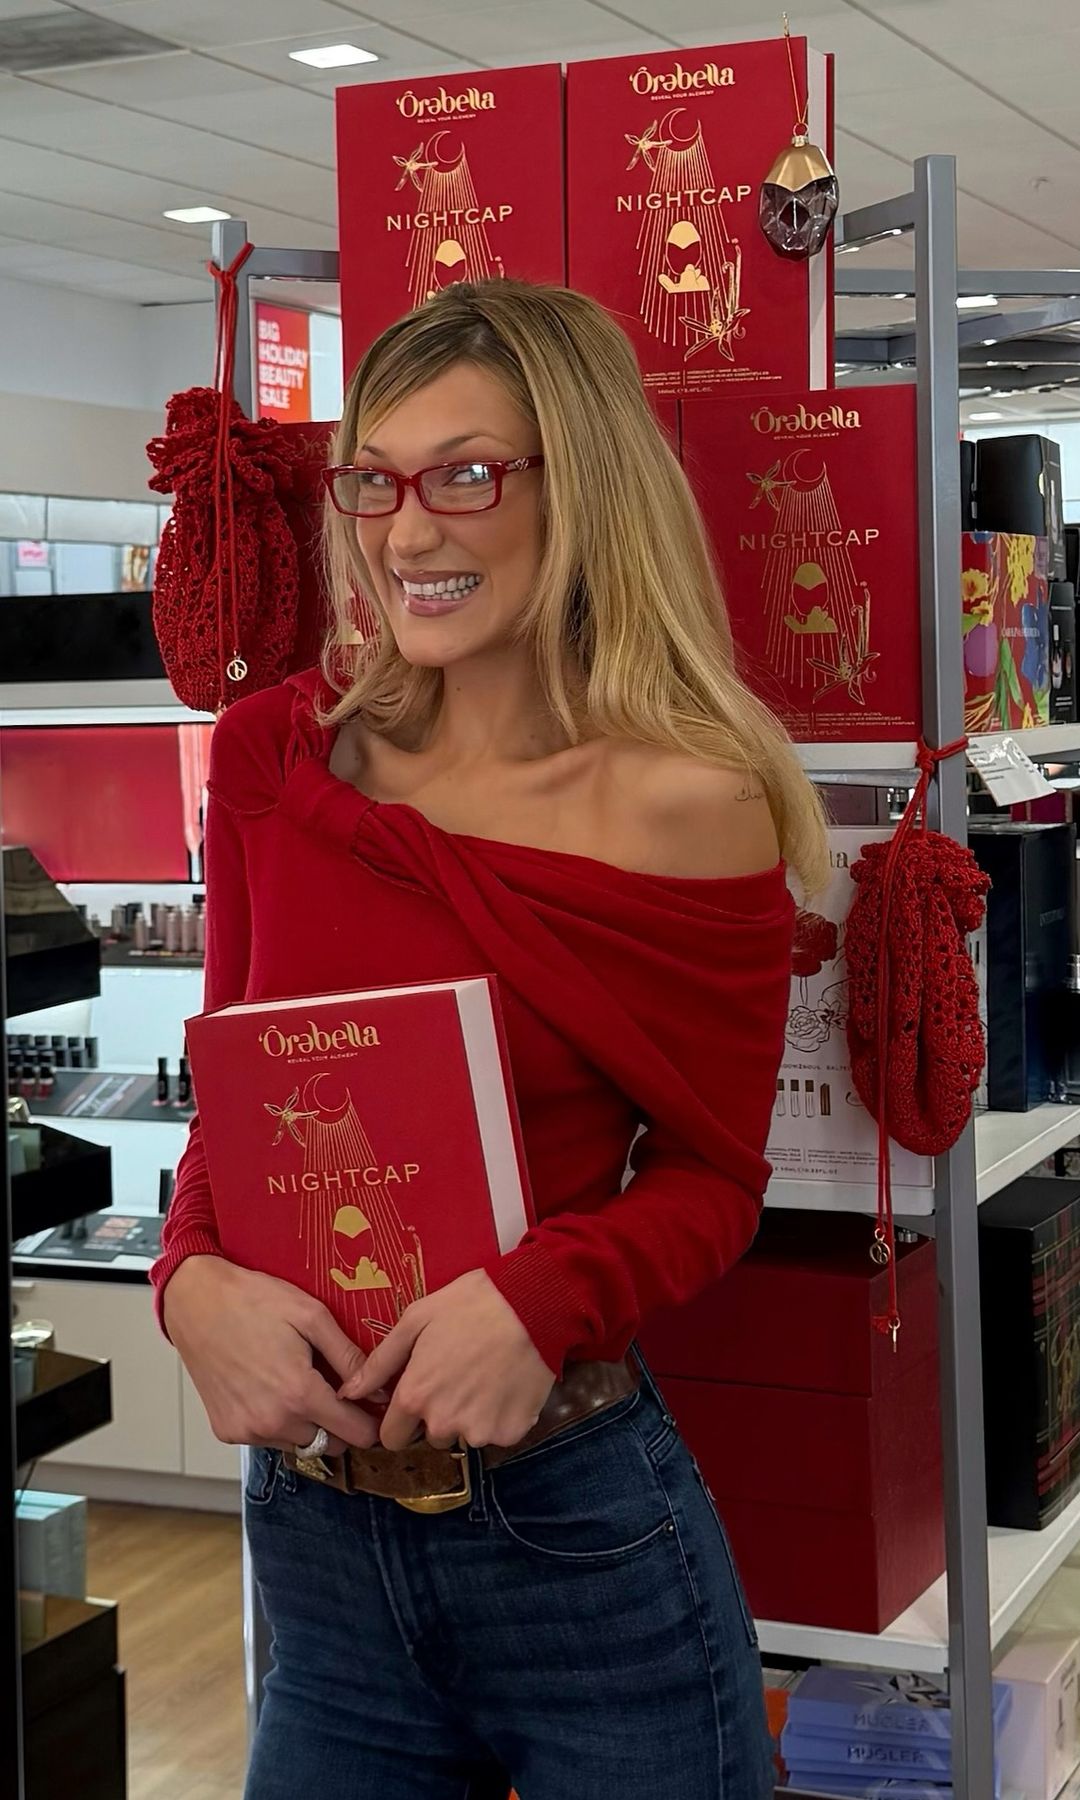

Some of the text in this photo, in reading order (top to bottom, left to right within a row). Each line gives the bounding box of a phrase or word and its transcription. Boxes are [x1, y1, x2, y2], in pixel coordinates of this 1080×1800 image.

[616, 185, 752, 212] NIGHTCAP
[387, 205, 513, 231] NIGHTCAP
[258, 319, 280, 341] BIG
[258, 341, 308, 368] HOLIDAY
[259, 363, 305, 390] BEAUTY
[259, 385, 291, 409] SALE
[740, 528, 880, 550] NIGHTCAP
[268, 1164, 421, 1194] NIGHTCAP
[853, 1712, 931, 1732] MUGLER
[847, 1745, 925, 1763] MUGLER
